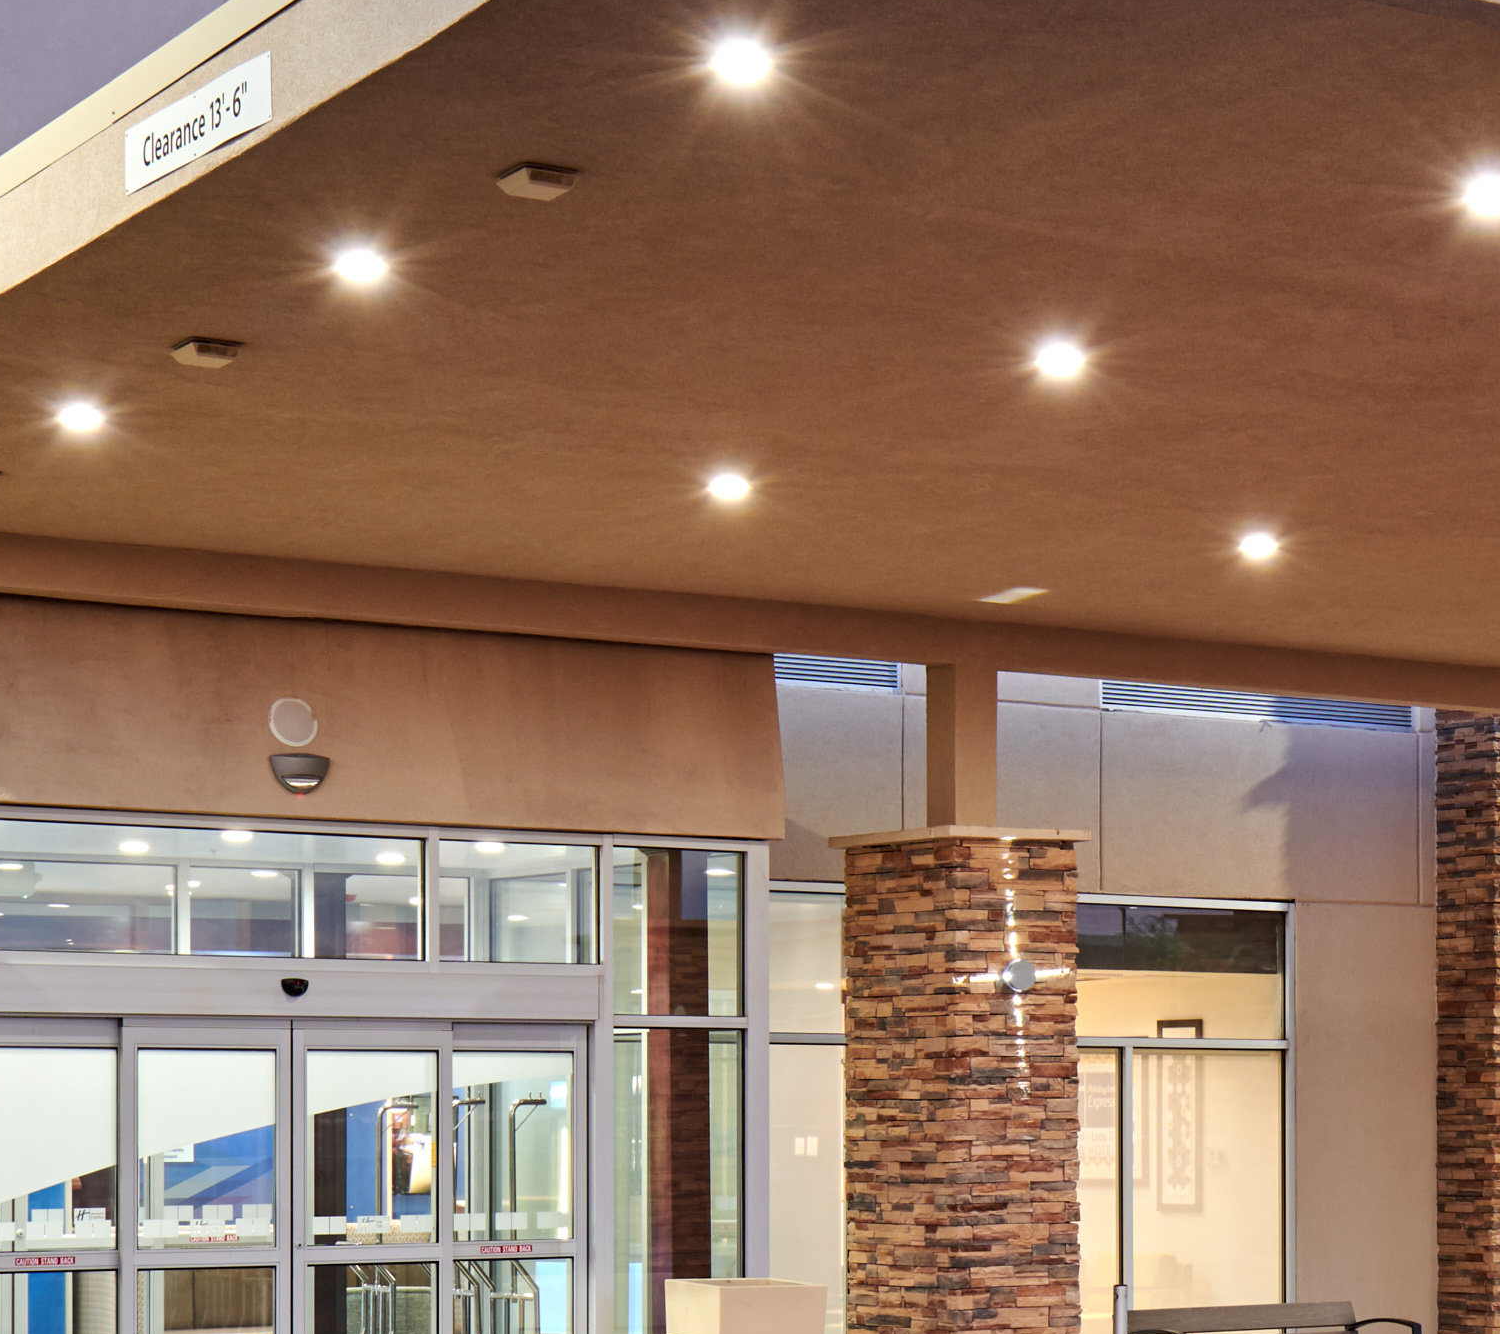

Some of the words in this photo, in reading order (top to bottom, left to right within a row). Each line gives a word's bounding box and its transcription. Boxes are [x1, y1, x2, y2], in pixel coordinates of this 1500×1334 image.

[143, 114, 206, 166] Clearance
[209, 81, 247, 131] 13'-6"
[481, 1246, 501, 1254] CAUTION
[16, 1258, 39, 1266] CAUTION
[41, 1257, 58, 1265] STAND
